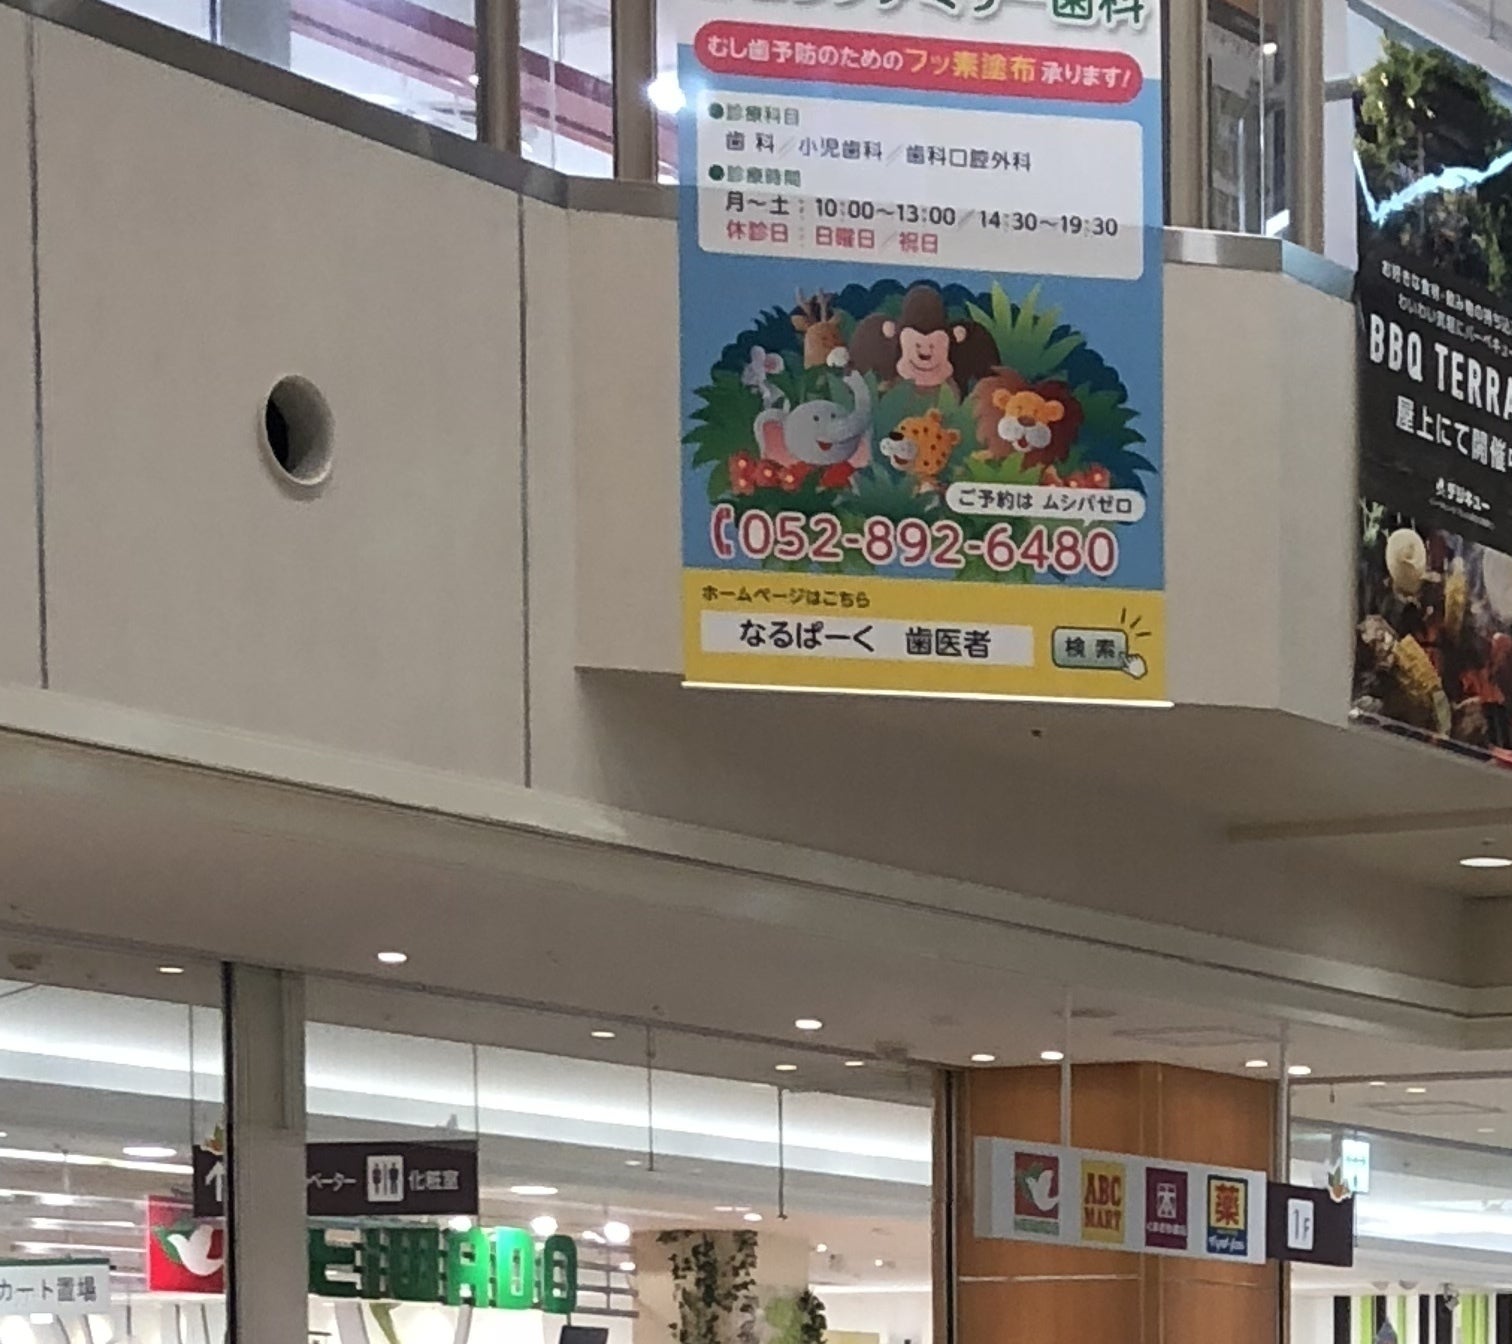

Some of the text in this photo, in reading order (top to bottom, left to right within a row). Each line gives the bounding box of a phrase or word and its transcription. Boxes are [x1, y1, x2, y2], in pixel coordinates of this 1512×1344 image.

[1369, 313, 1424, 383] BBQ
[740, 514, 1118, 574] 052-892-6480
[701, 587, 871, 609] ホームページはこちら
[1084, 1172, 1122, 1206] ABC
[1083, 1207, 1121, 1233] MART
[1293, 1208, 1311, 1242] 1F
